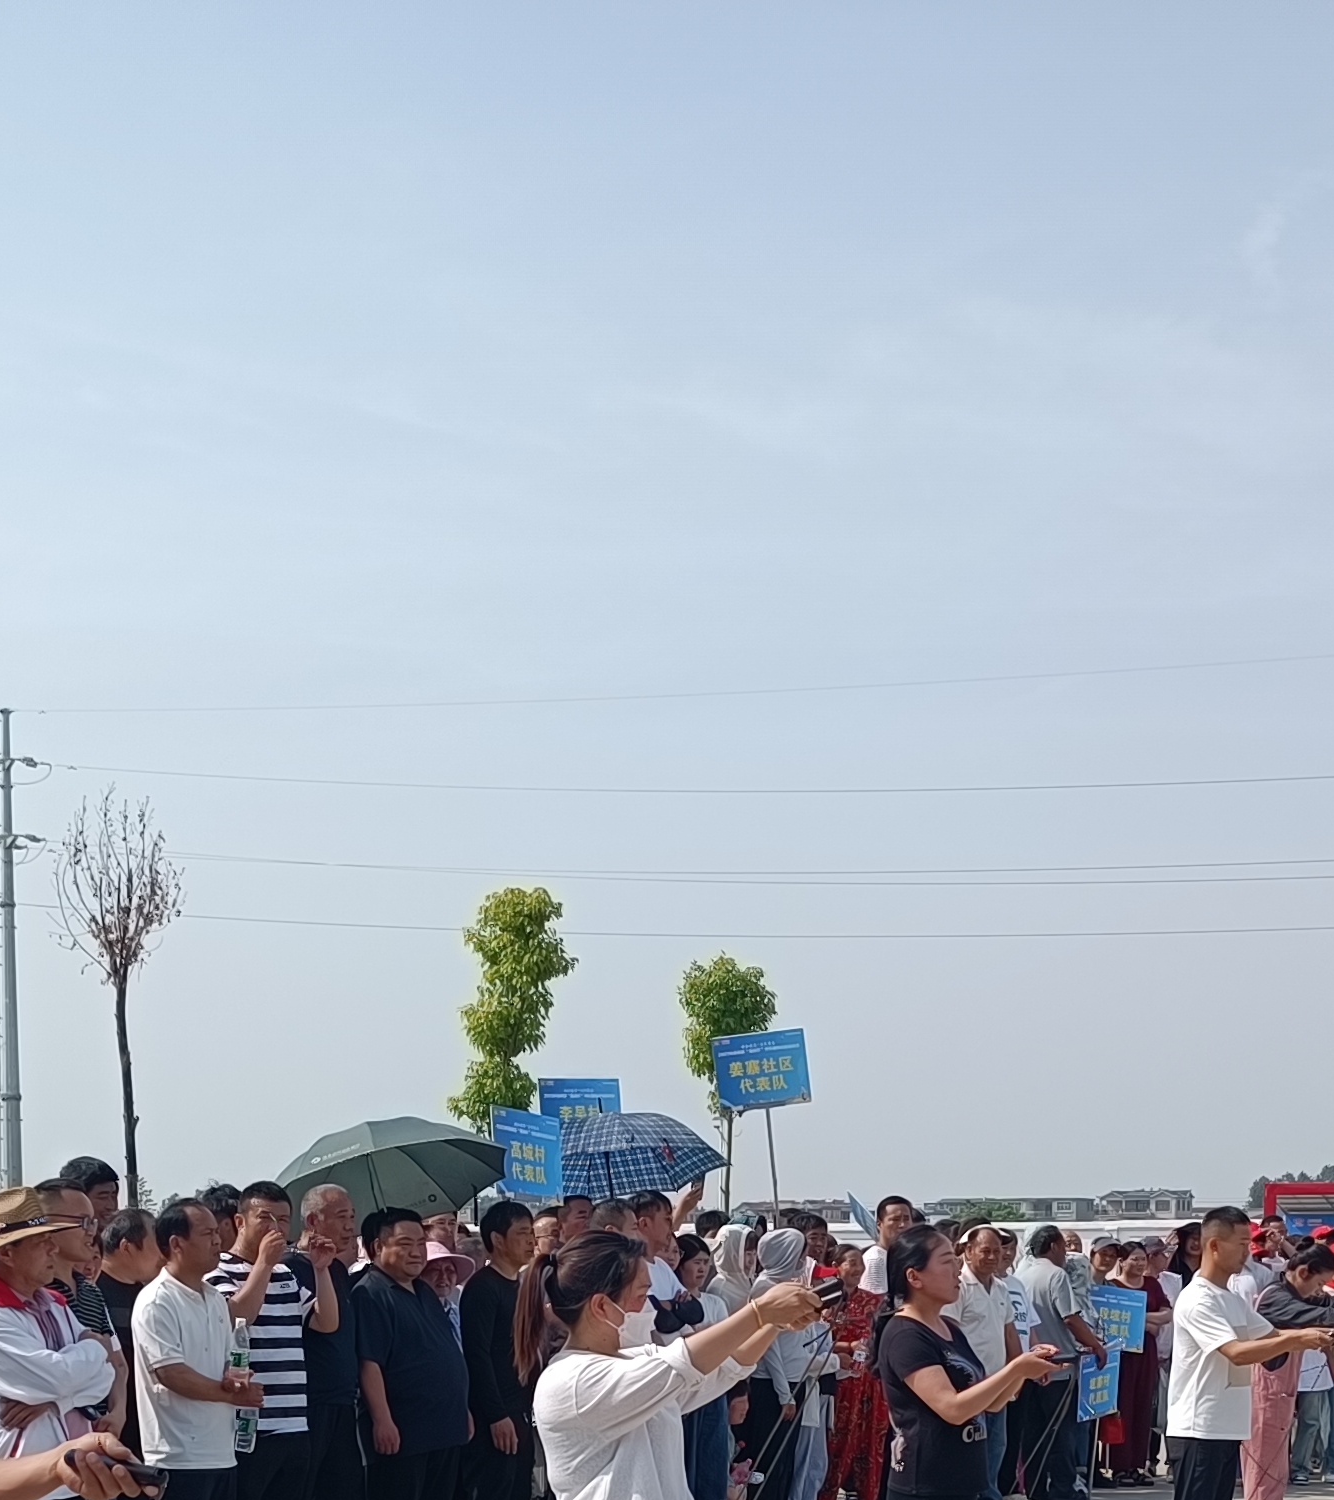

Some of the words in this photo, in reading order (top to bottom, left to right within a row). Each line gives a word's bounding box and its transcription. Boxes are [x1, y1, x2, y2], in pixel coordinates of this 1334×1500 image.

[739, 1074, 788, 1095] 代表队
[511, 1161, 547, 1185] 代表队
